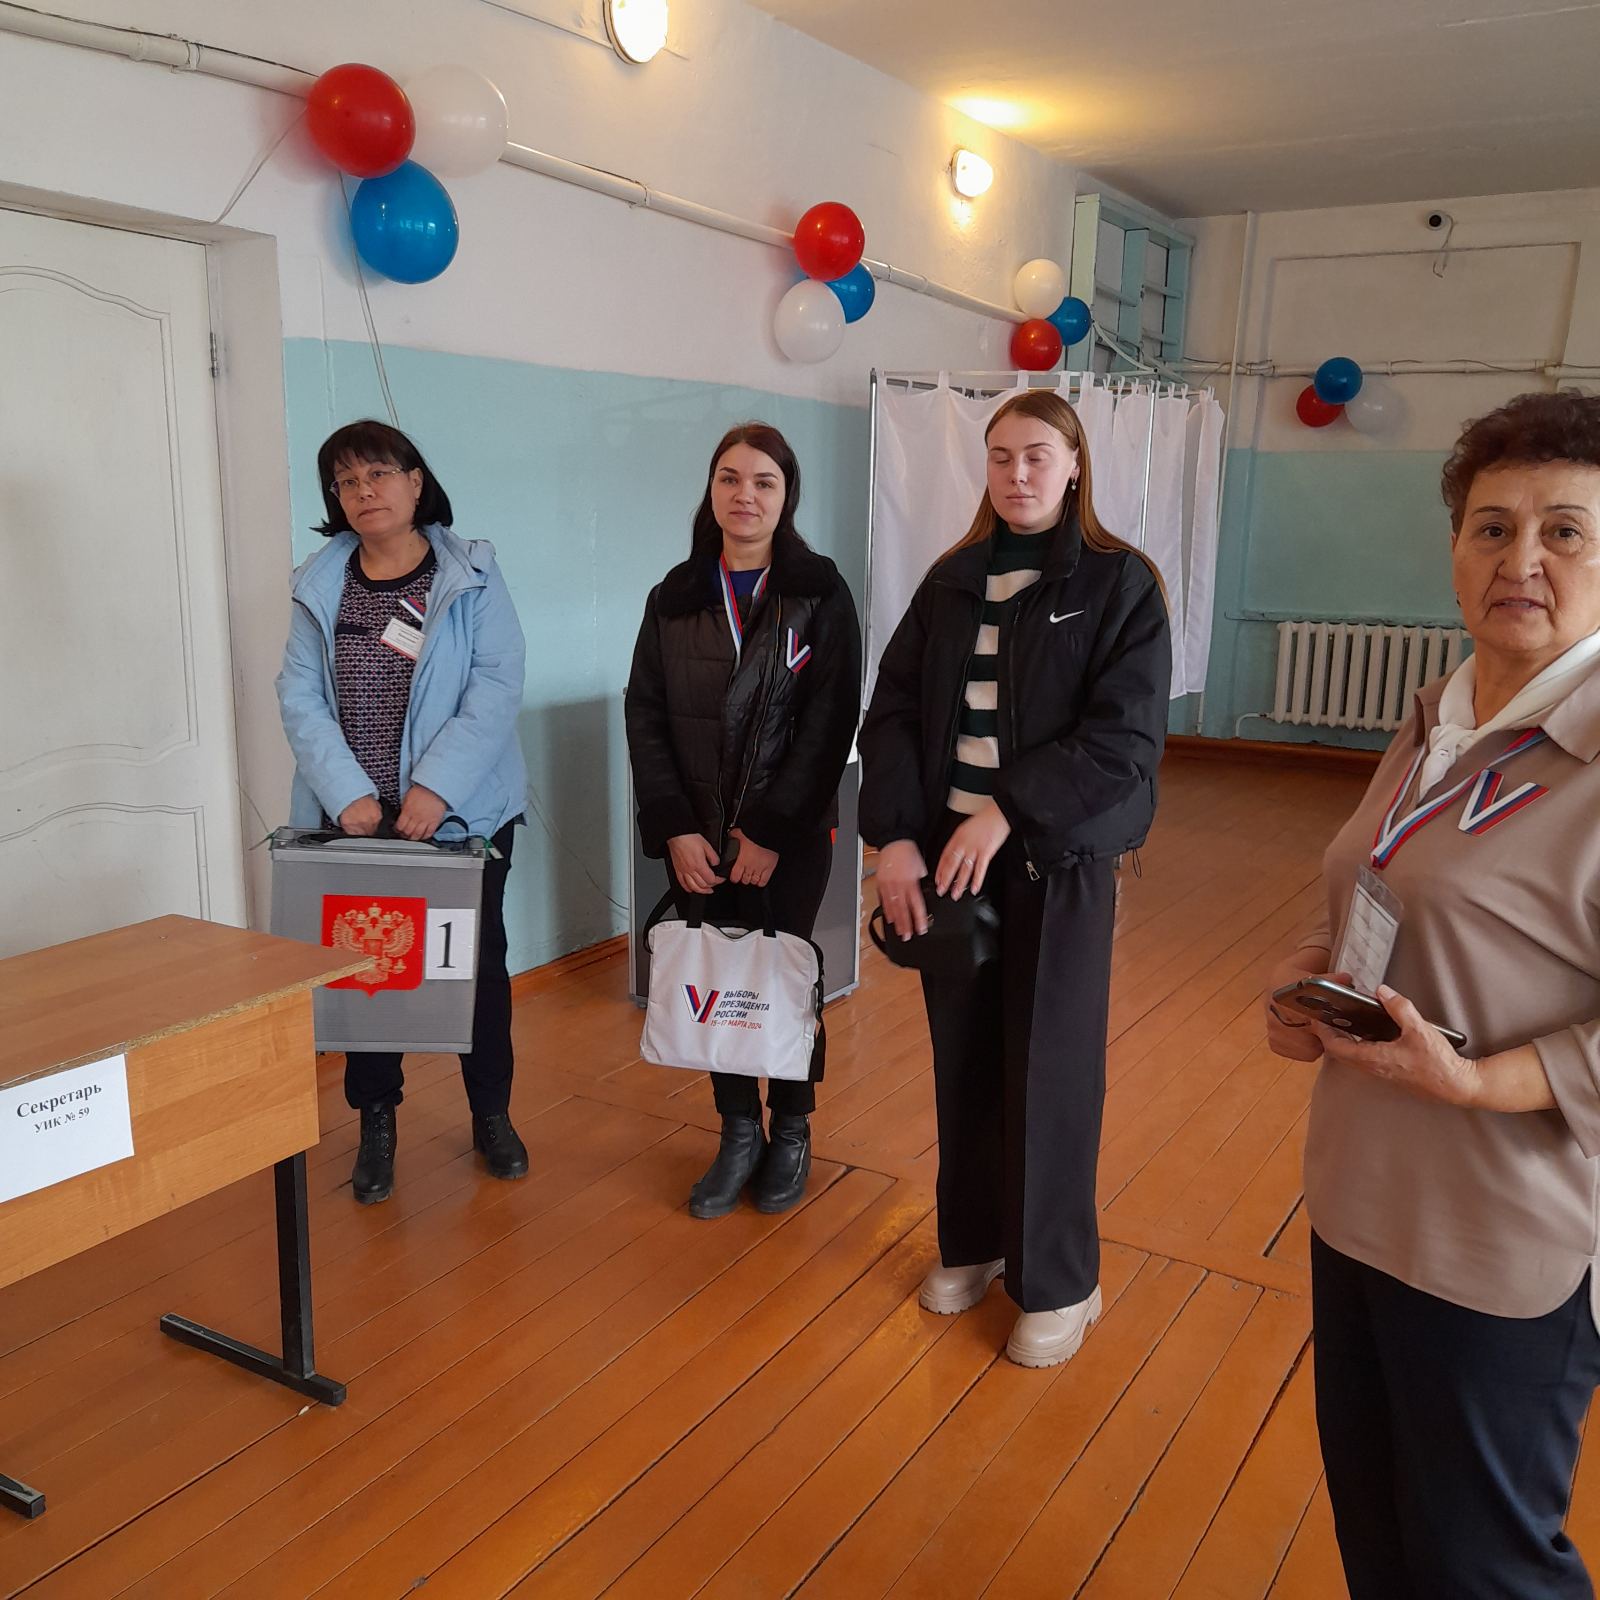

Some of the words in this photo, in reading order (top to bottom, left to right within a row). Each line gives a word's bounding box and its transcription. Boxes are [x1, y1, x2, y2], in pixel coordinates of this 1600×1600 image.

[436, 921, 457, 969] 1
[723, 990, 760, 1000] ВЫБОРЫ
[718, 1000, 770, 1012] ПРЕЗИДЕНТА
[713, 1010, 748, 1019] РОССИИ
[727, 1020, 747, 1028] МАРТА
[747, 1022, 762, 1030] 2024
[16, 1084, 102, 1118] Секретарь
[34, 1116, 62, 1134] УИК
[64, 1111, 76, 1124] №
[78, 1106, 90, 1119] 59
